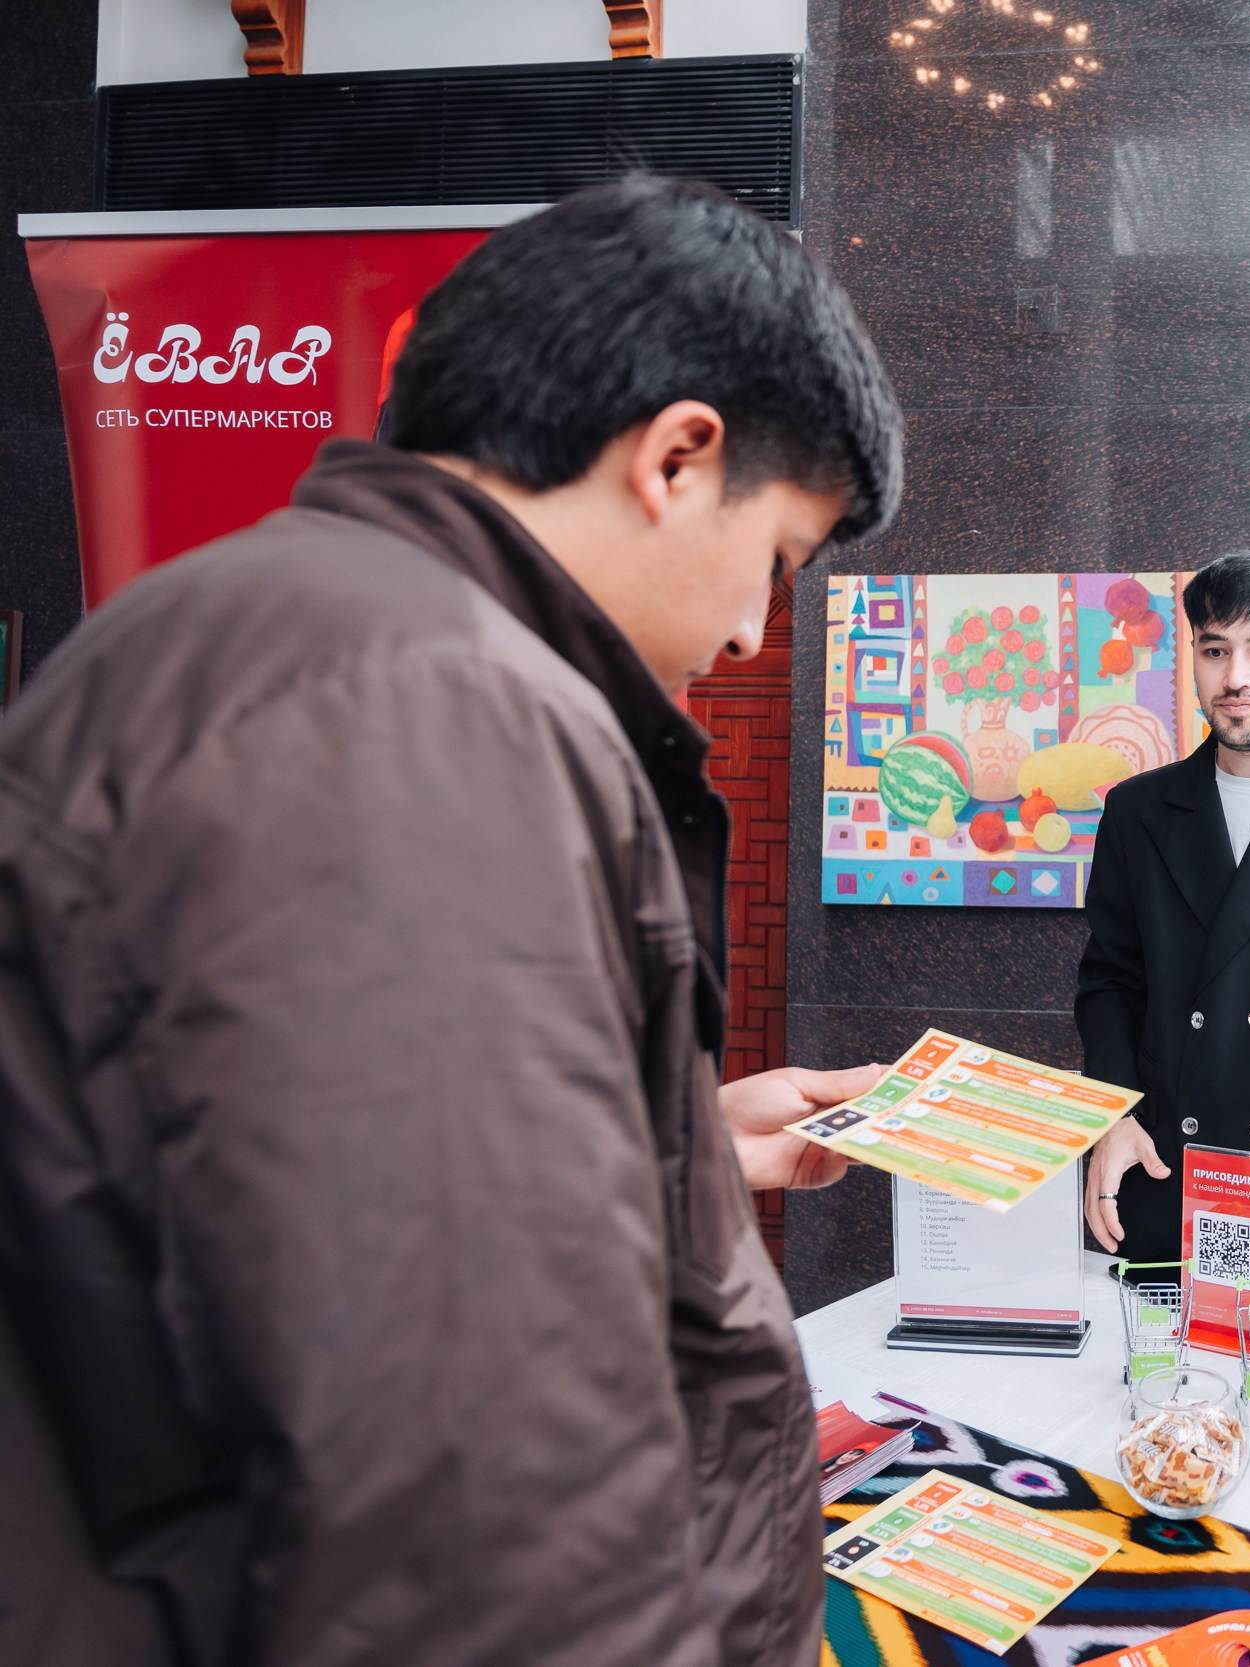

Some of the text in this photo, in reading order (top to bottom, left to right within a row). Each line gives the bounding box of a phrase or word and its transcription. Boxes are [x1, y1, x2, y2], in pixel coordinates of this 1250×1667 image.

[93, 311, 332, 386] ЁВАР
[96, 408, 333, 429] СЕТЬ СУПЕРМАРКЕТОВ
[1198, 1184, 1224, 1194] нашей
